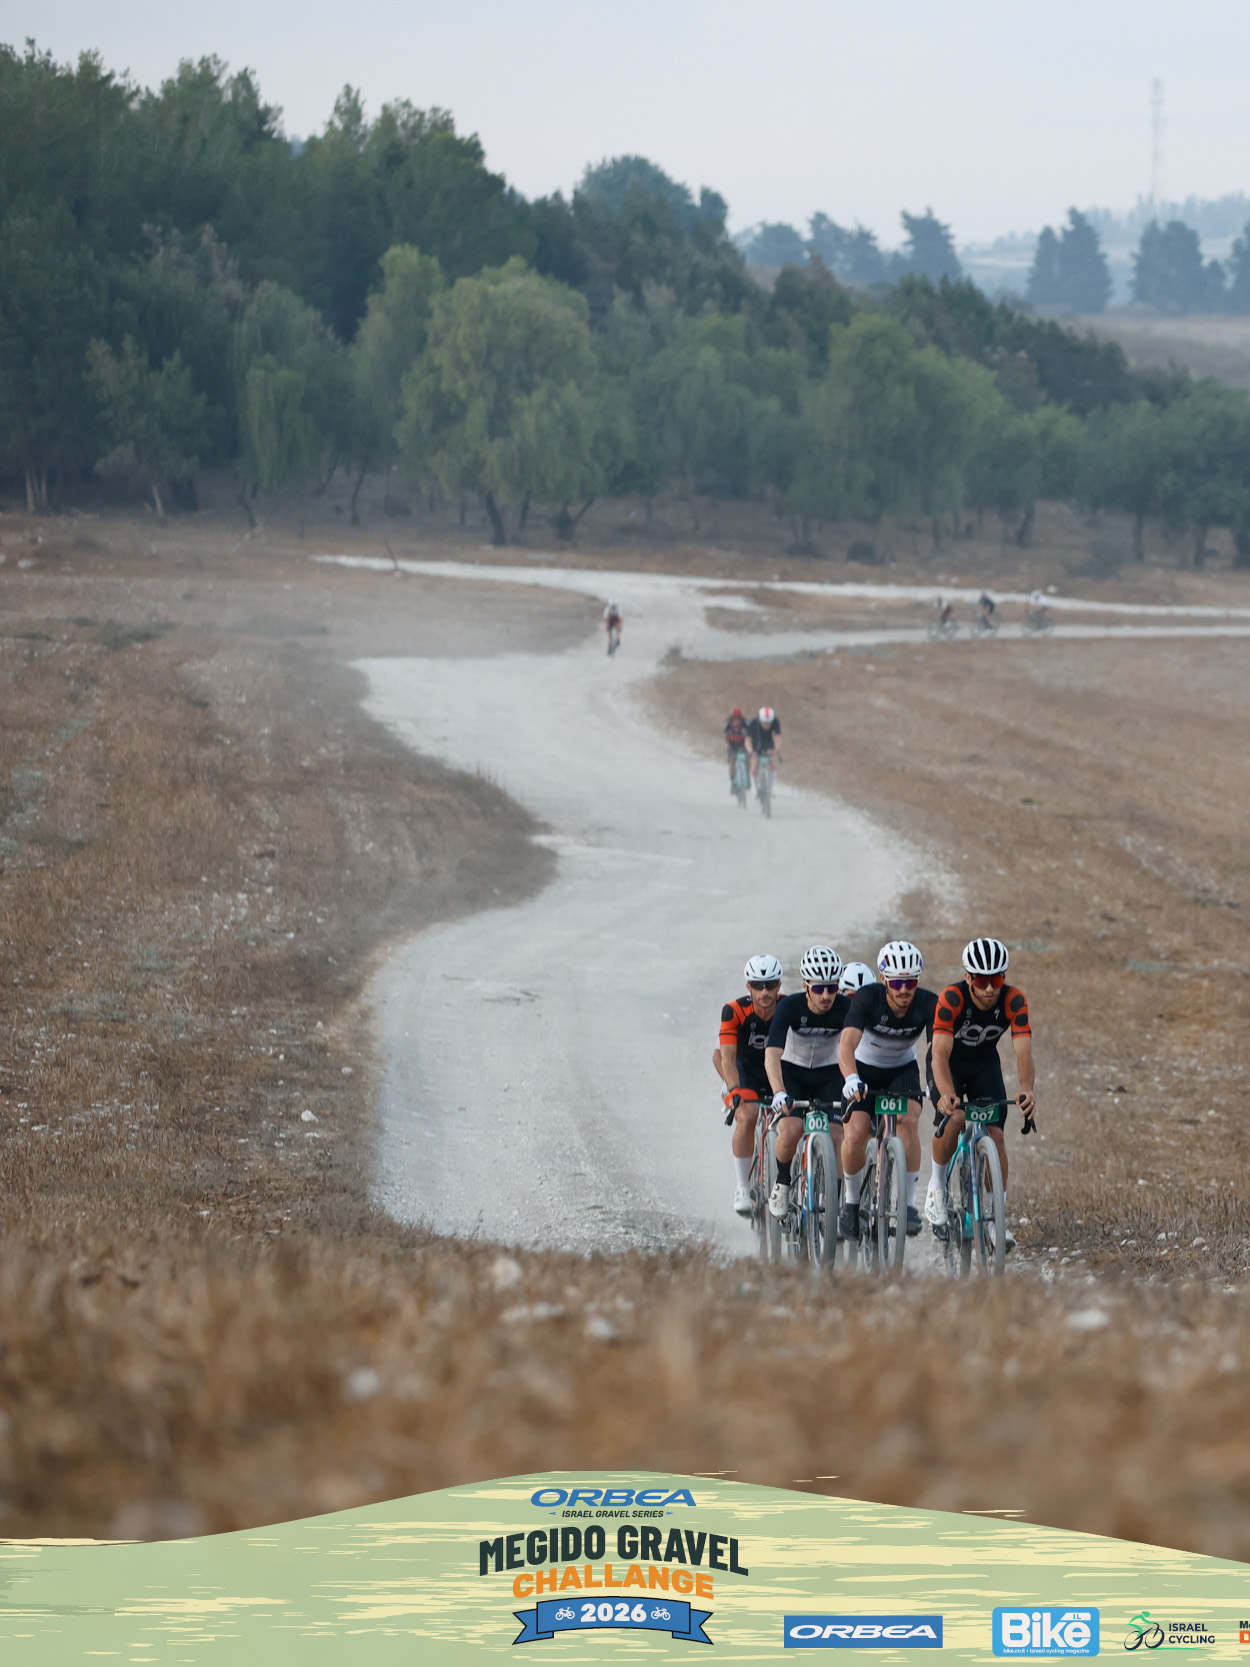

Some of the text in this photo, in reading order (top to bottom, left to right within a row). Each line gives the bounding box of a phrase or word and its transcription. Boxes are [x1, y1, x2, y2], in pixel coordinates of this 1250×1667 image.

[881, 1098, 902, 1111] 061
[970, 1110, 994, 1121] 007
[808, 1117, 828, 1131] 002
